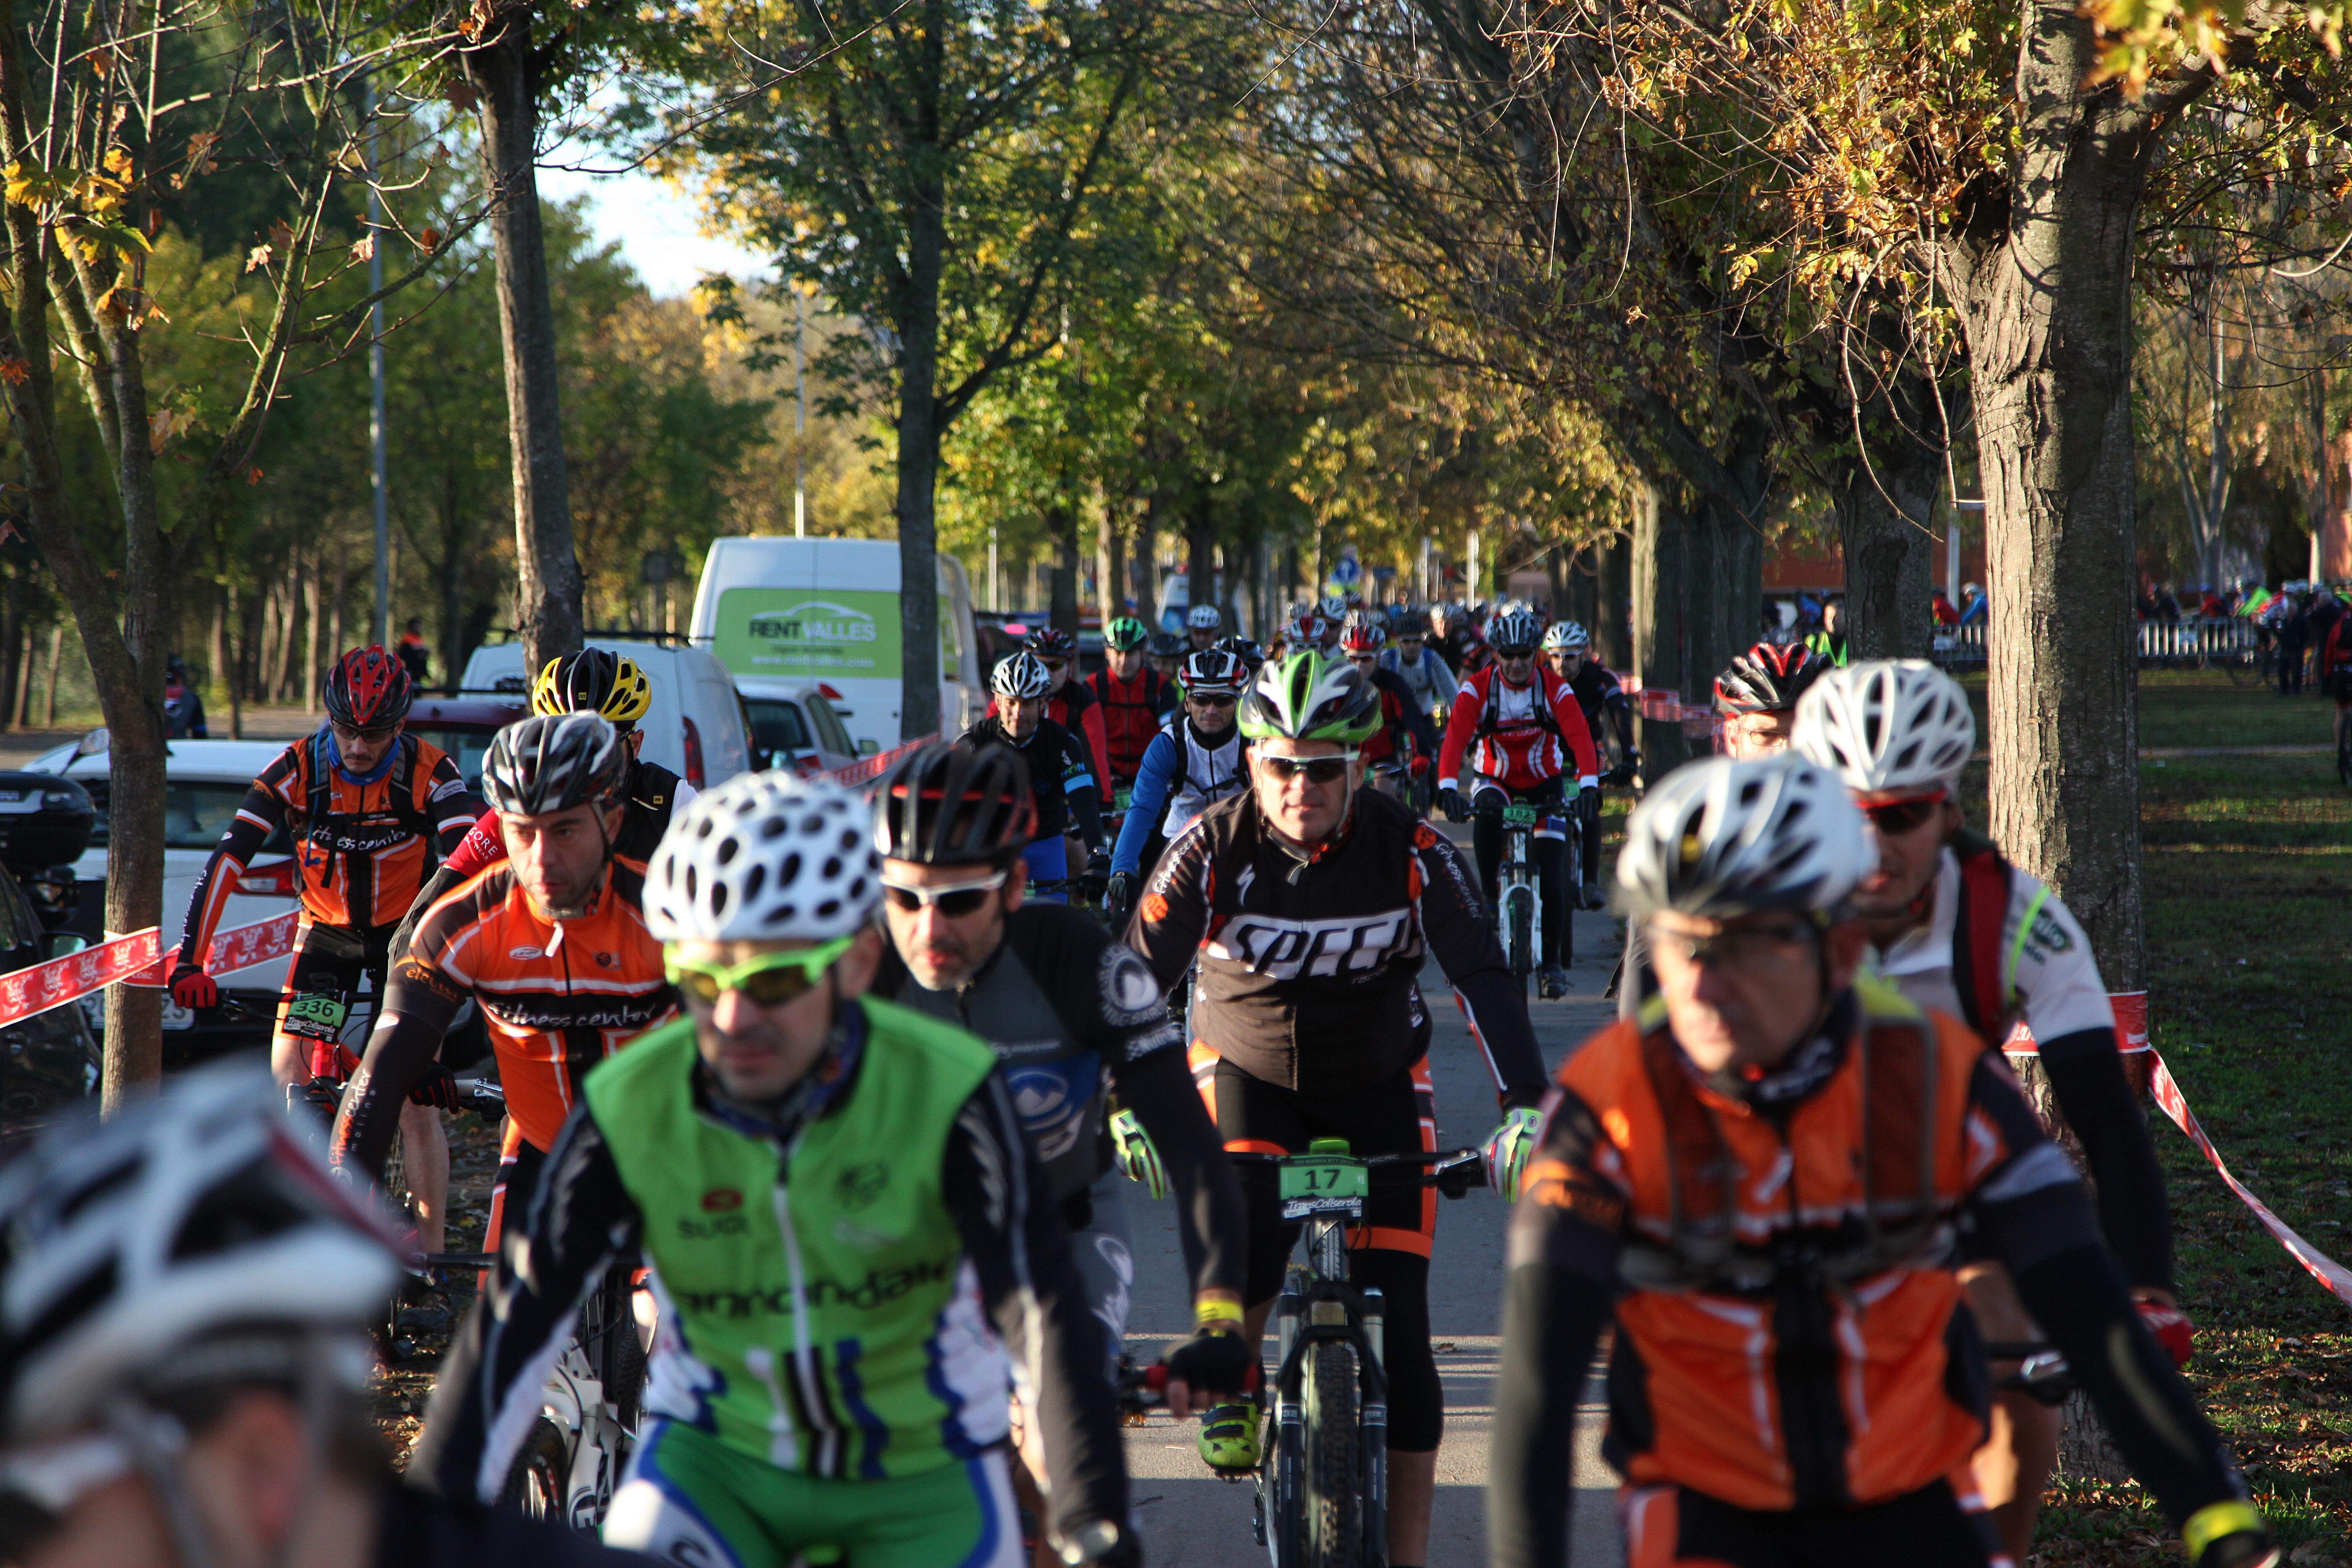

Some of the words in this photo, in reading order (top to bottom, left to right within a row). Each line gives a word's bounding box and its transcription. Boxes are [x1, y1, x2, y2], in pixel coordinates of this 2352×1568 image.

[468, 827, 498, 856] GORE
[295, 1000, 335, 1017] 336
[575, 1004, 657, 1027] center
[1305, 1169, 1341, 1191] 17
[1287, 1197, 1362, 1210] TransCollserola
